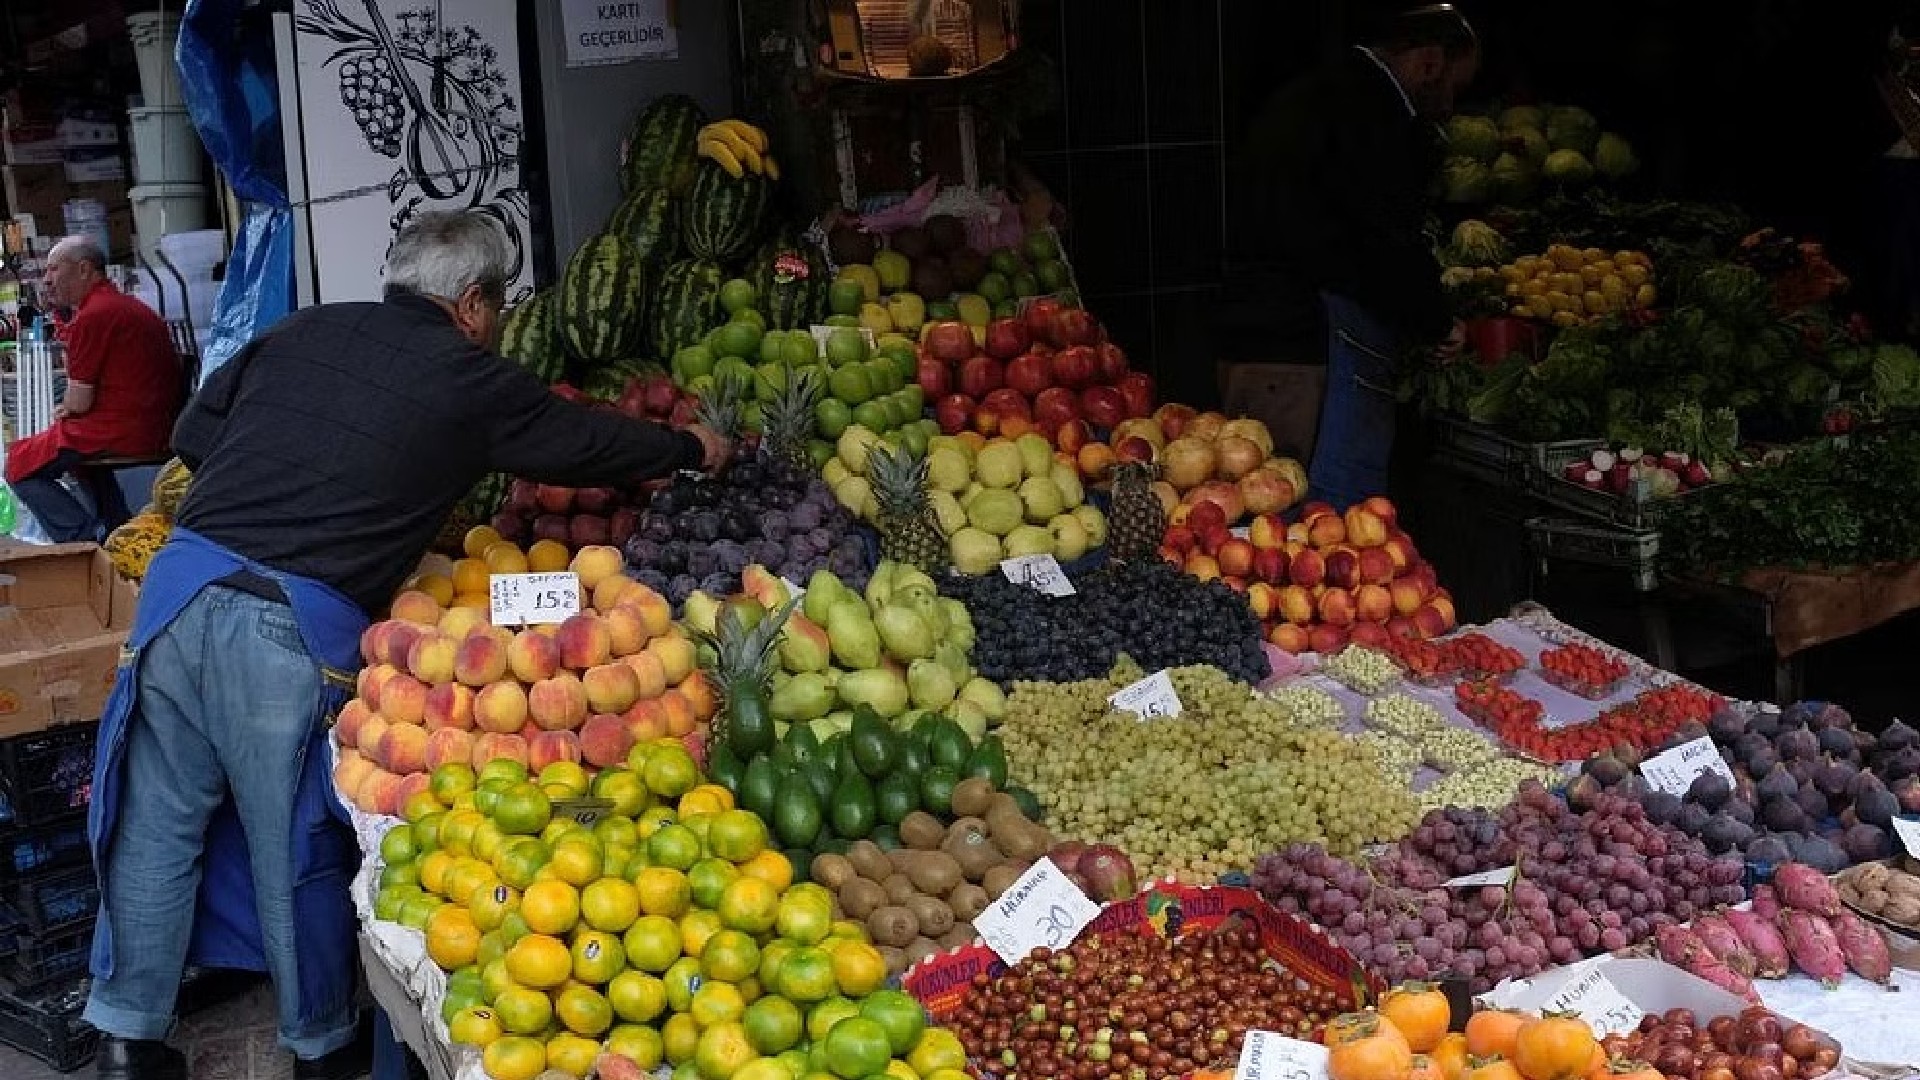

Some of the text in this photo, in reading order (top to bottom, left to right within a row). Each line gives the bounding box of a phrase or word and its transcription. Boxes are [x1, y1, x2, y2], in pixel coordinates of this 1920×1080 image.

[597, 3, 639, 19] KARTI
[579, 24, 664, 48] GEÇERLİDİR
[1035, 904, 1075, 947] 30
